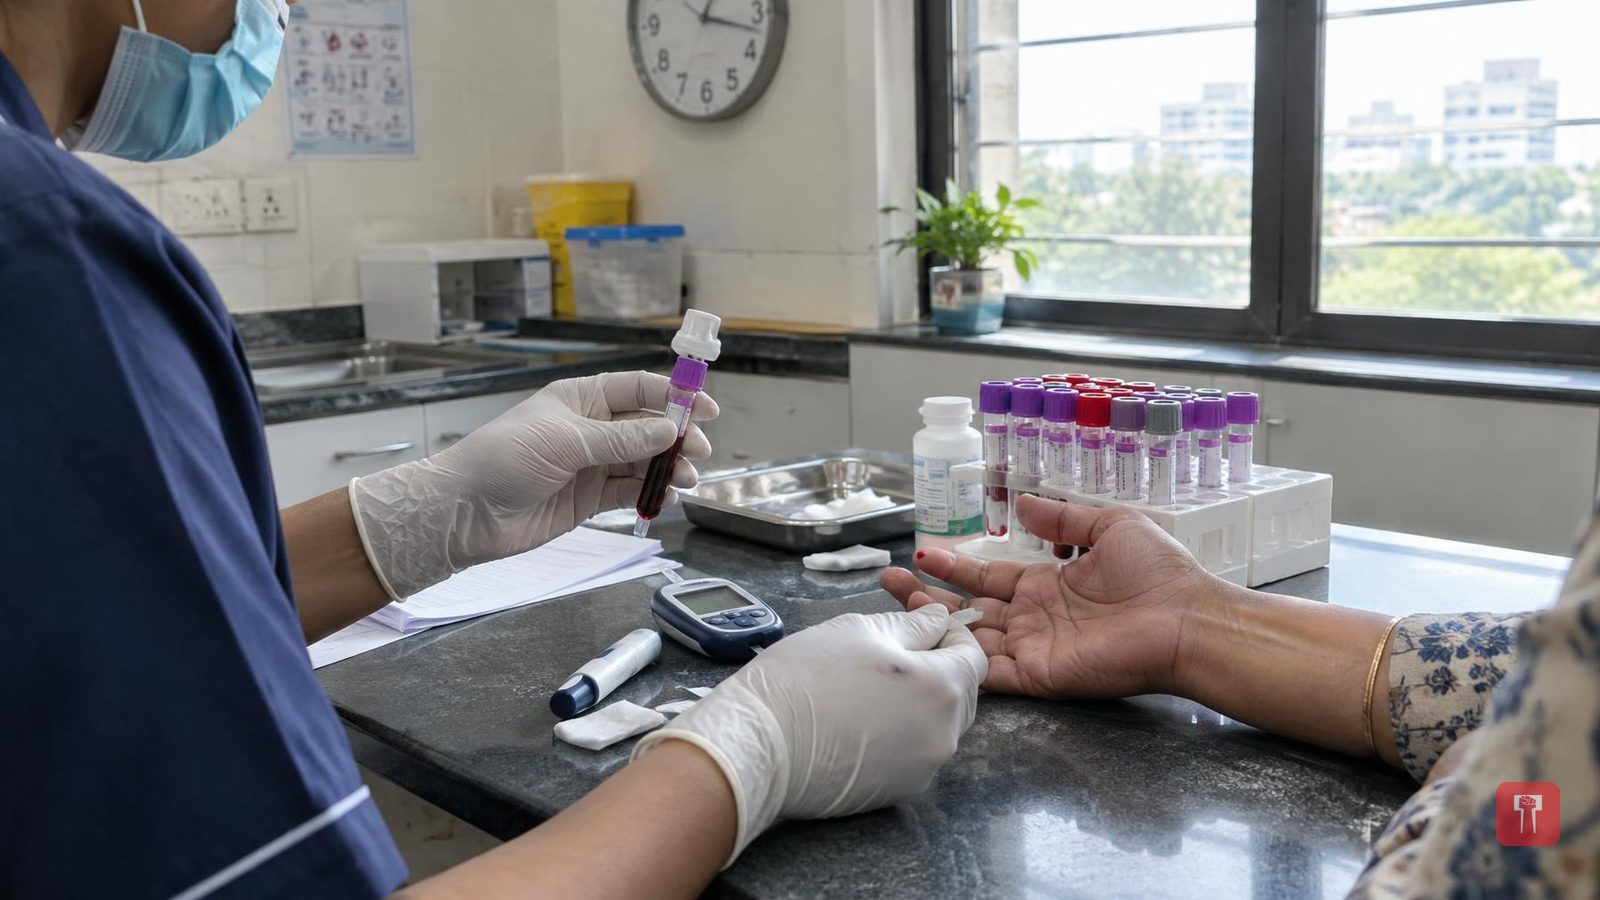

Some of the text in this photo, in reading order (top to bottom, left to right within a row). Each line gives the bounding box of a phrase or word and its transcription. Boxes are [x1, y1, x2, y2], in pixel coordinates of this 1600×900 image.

[751, 1, 764, 24] 3
[648, 13, 660, 37] 9
[658, 49, 670, 72] 8
[744, 39, 757, 60] 4
[676, 73, 688, 96] 7
[701, 80, 713, 103] 6
[726, 68, 738, 92] 5
